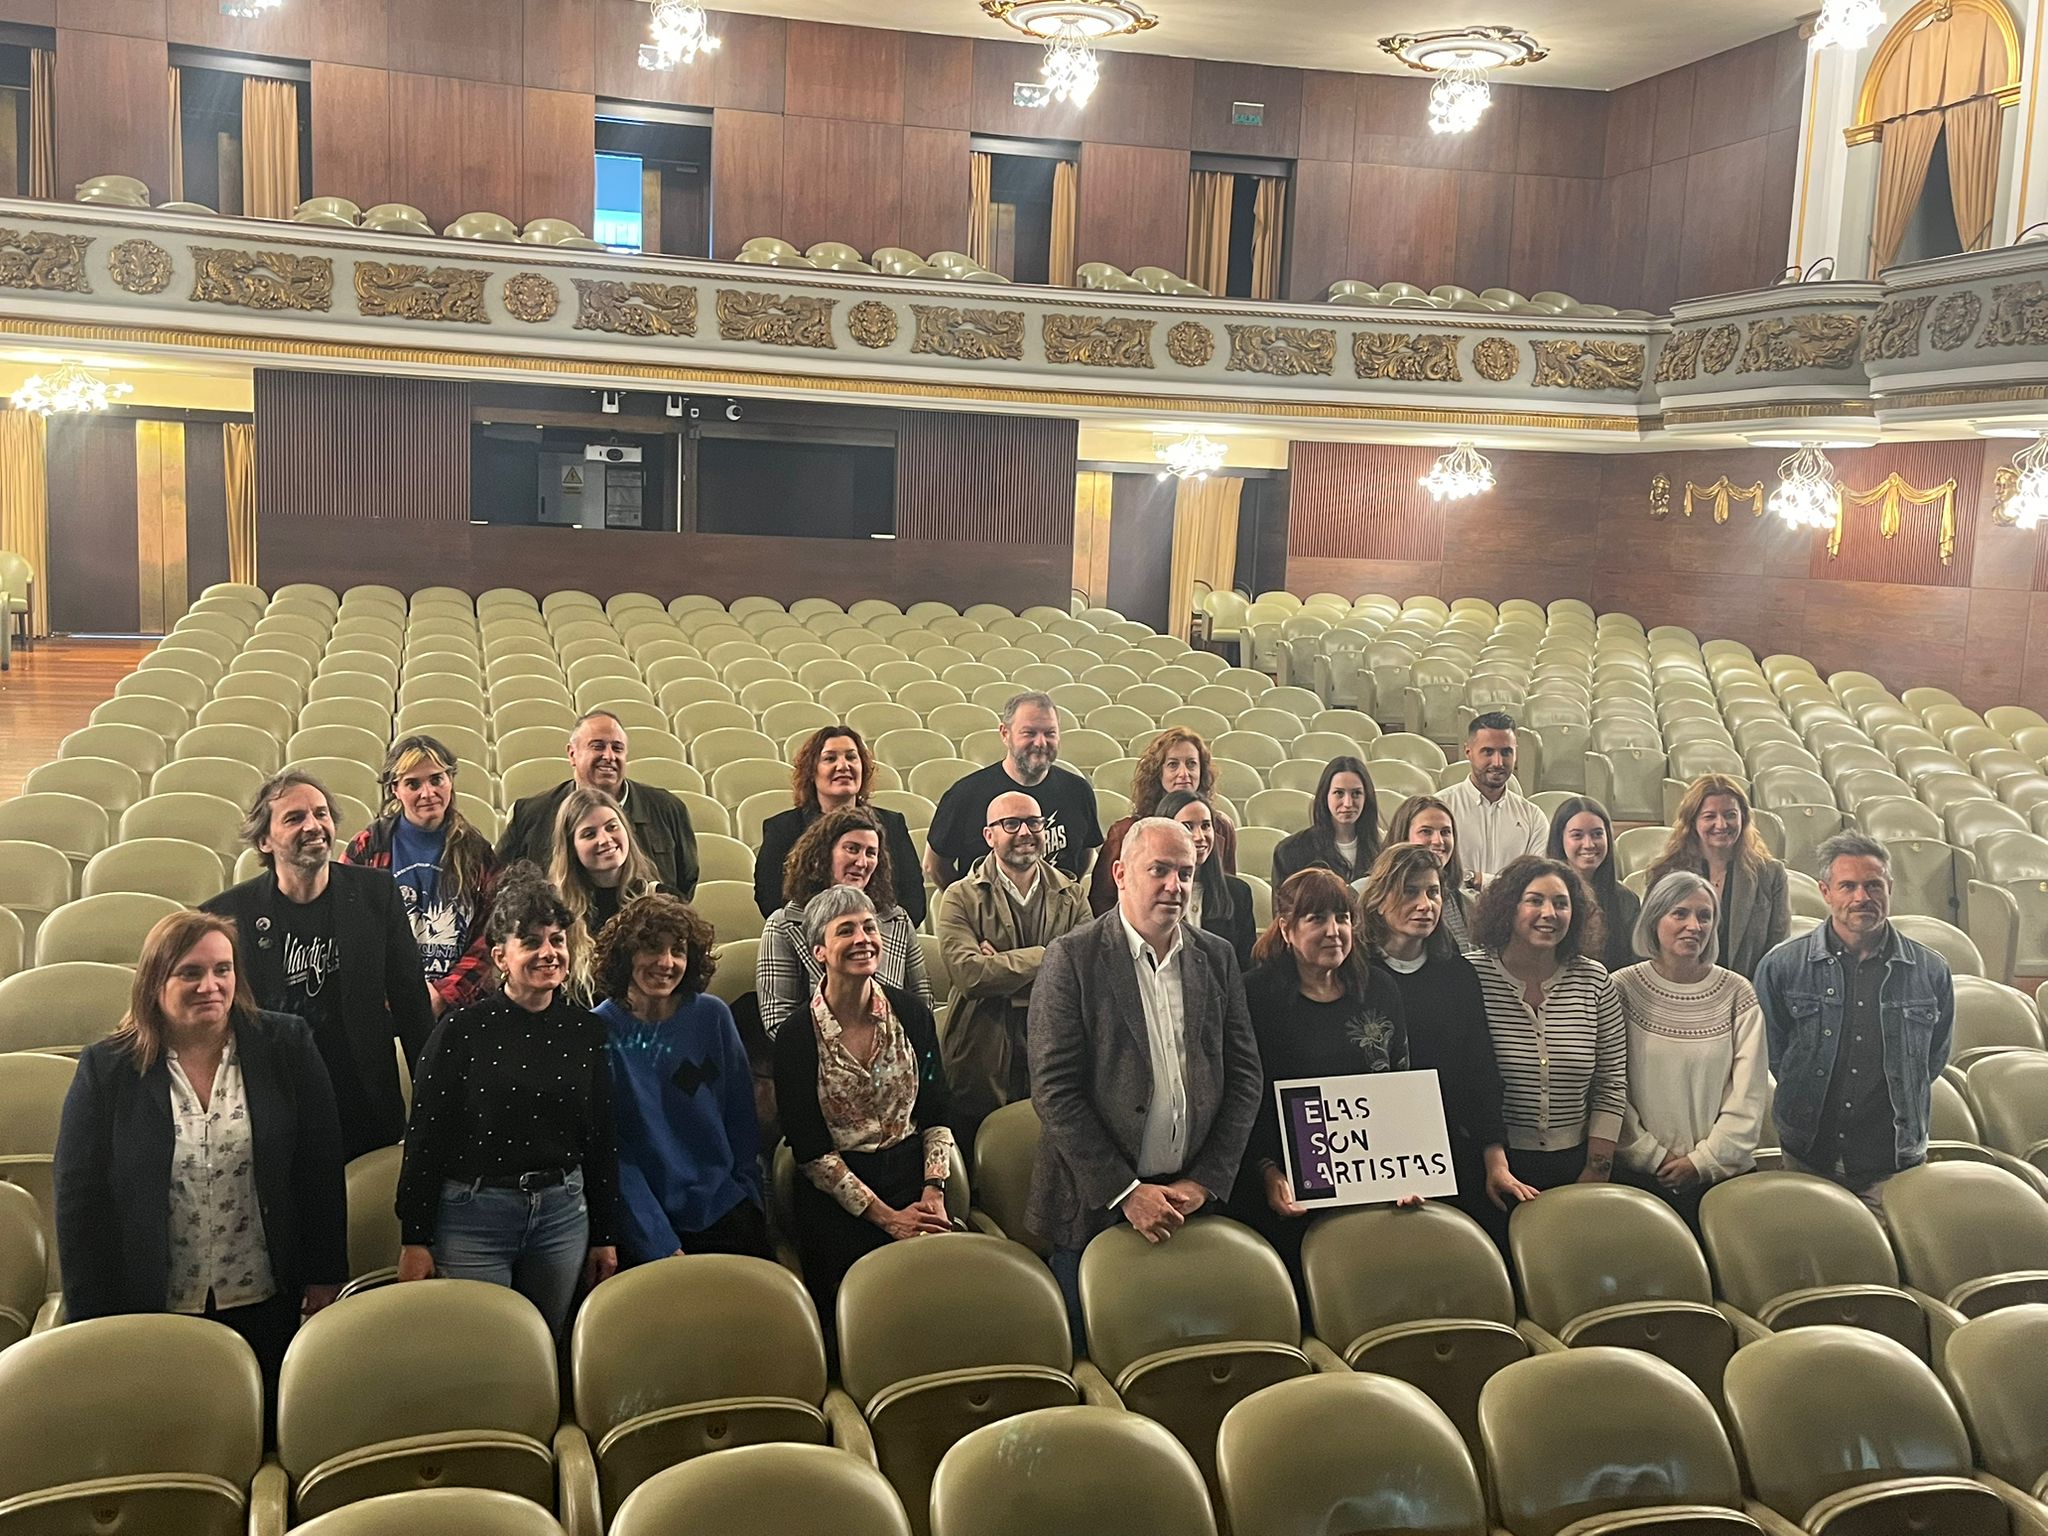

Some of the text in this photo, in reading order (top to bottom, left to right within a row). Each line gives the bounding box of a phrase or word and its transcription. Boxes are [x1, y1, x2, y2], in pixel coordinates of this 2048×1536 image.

[1304, 1097, 1370, 1124] ELAS
[1310, 1129, 1369, 1155] SON
[1316, 1153, 1447, 1186] ARTISTAS
